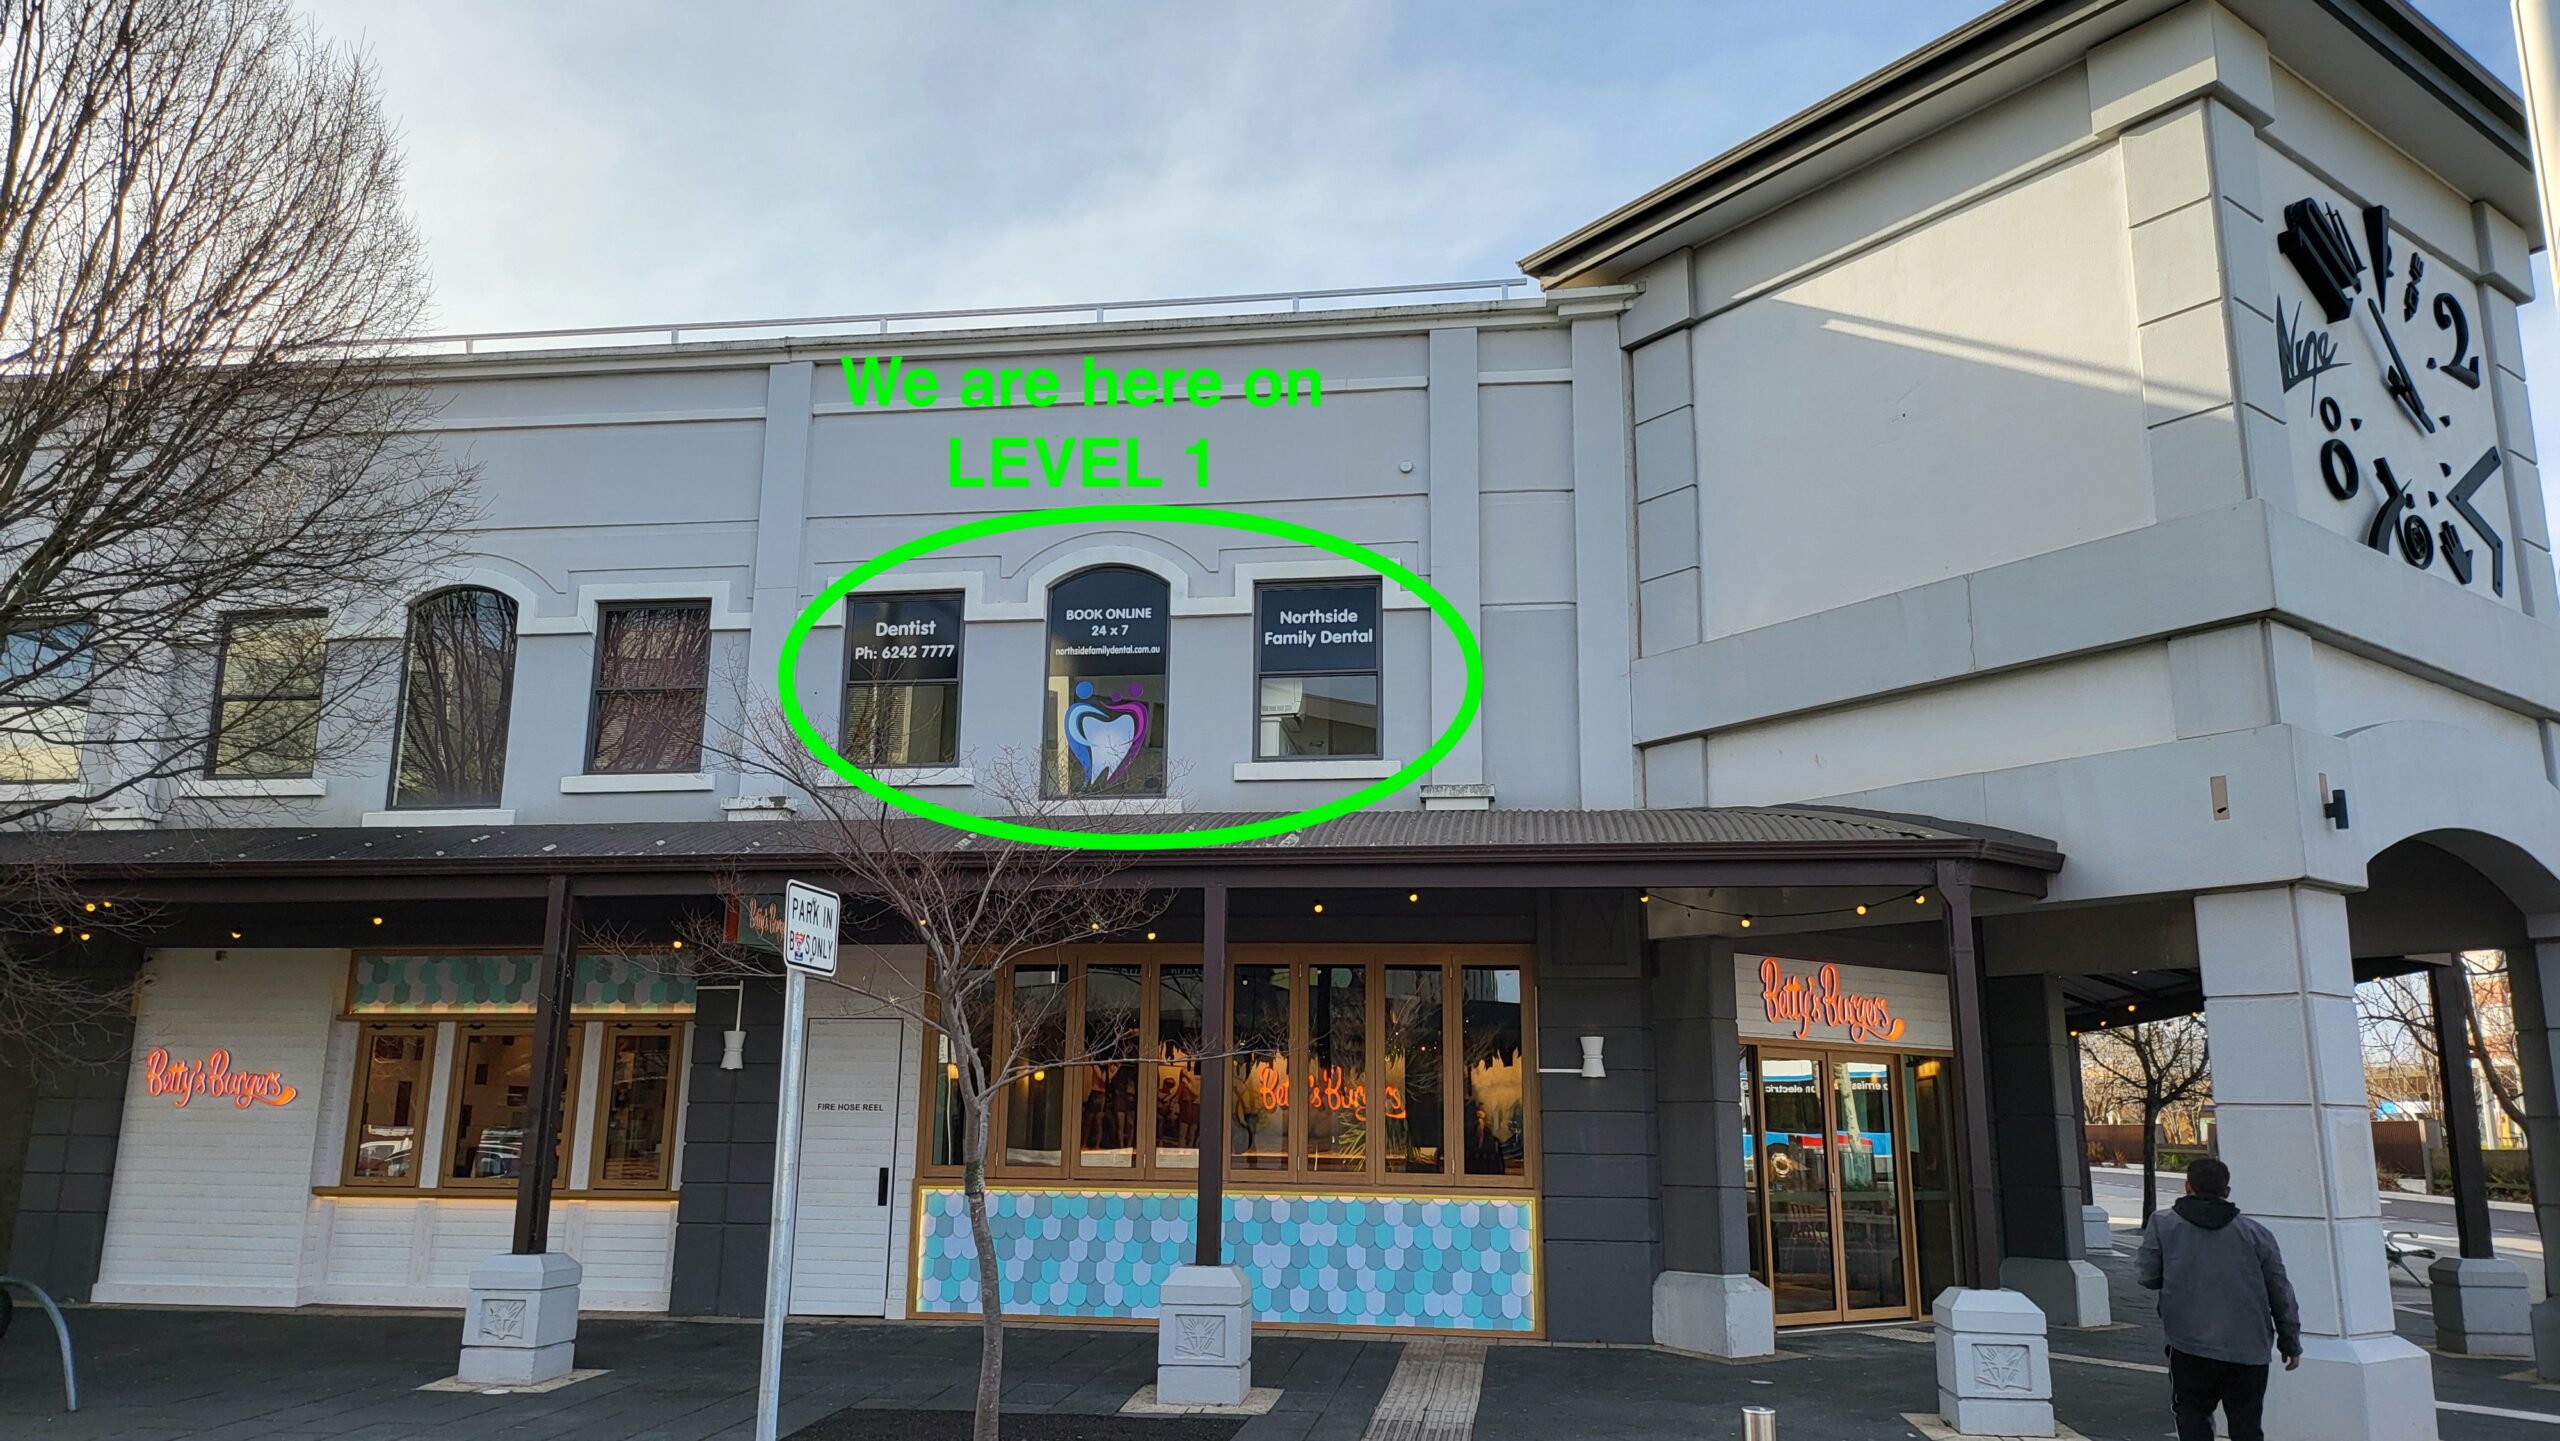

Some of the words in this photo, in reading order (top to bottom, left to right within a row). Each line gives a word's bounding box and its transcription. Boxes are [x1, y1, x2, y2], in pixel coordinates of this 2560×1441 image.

[2433, 293, 2481, 389] 2
[1066, 609, 1103, 620] BOOK
[1106, 608, 1152, 619] ONLINE
[1280, 608, 1358, 624] Northside
[876, 620, 937, 636] Dentist
[1091, 625, 1107, 636] 24
[1110, 627, 1118, 636] x
[1121, 625, 1129, 636] 7
[1265, 630, 1316, 648] Family
[1321, 628, 1373, 644] Dental
[855, 646, 878, 660] Ph:
[882, 646, 917, 659] 6242
[921, 644, 955, 658] 7777
[1055, 645, 1161, 656] northsidefamilydental.com.au
[792, 897, 820, 926] PARK
[823, 906, 833, 930] IN
[789, 929, 811, 955] BS
[811, 936, 833, 960] ONLY
[1760, 957, 1822, 1040] Betty's
[1819, 963, 1905, 1042] Burgers
[147, 1047, 206, 1108] Betty's
[209, 1048, 297, 1109] Burgers
[817, 1103, 836, 1111] FIRE
[862, 1104, 884, 1112] REEL
